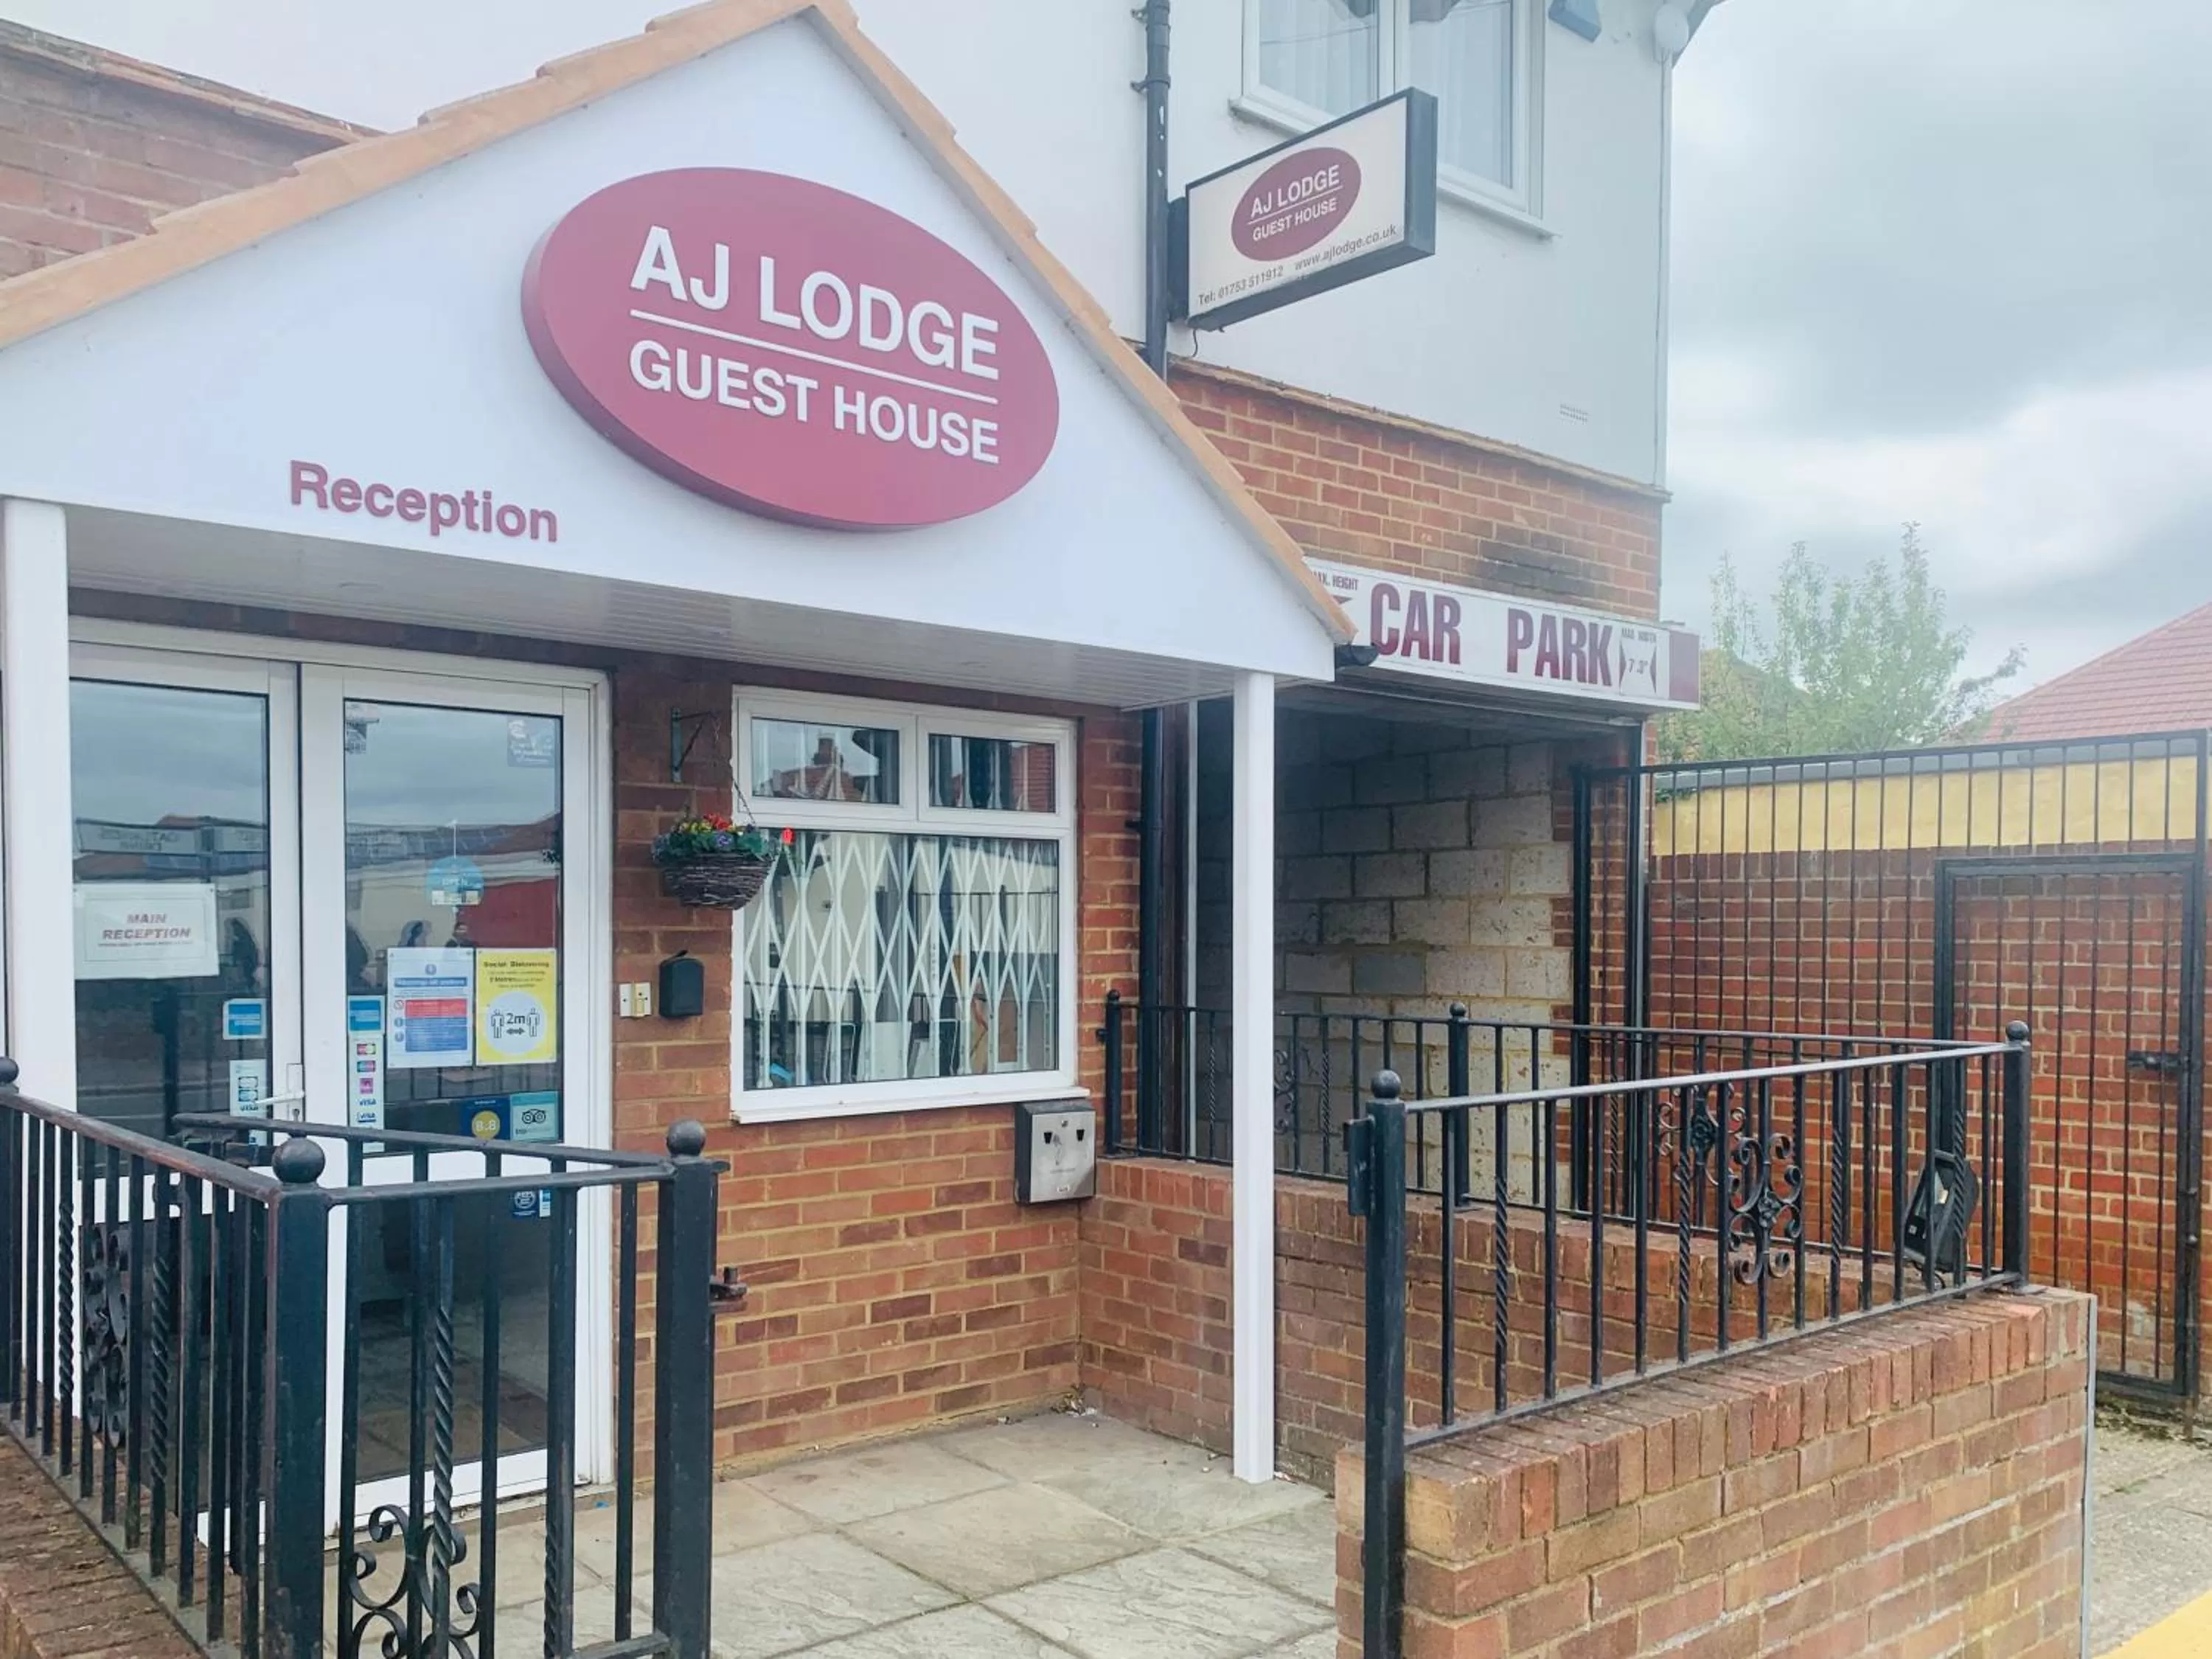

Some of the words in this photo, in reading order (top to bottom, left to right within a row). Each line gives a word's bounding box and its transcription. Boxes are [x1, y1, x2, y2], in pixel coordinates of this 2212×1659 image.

[1251, 192, 1272, 218] AJ
[1277, 164, 1340, 206] LODGE
[1253, 215, 1292, 241] GUEST
[1295, 198, 1337, 226] HOUSE
[1199, 292, 1216, 305] Tel:
[1218, 278, 1247, 299] 01753
[1248, 265, 1284, 288] 511912
[1294, 223, 1397, 271] www.ajlodge.co.uk
[630, 226, 729, 310] AJ
[759, 256, 999, 380] LODGE
[630, 340, 818, 422] GUEST
[834, 386, 999, 464] HOUSE
[291, 459, 557, 543] Reception
[1371, 582, 1461, 665] CAR
[1506, 606, 1613, 686] PARK
[102, 928, 192, 939] RECEPTION
[127, 914, 167, 924] MAIN
[507, 1012, 526, 1024] 2m
